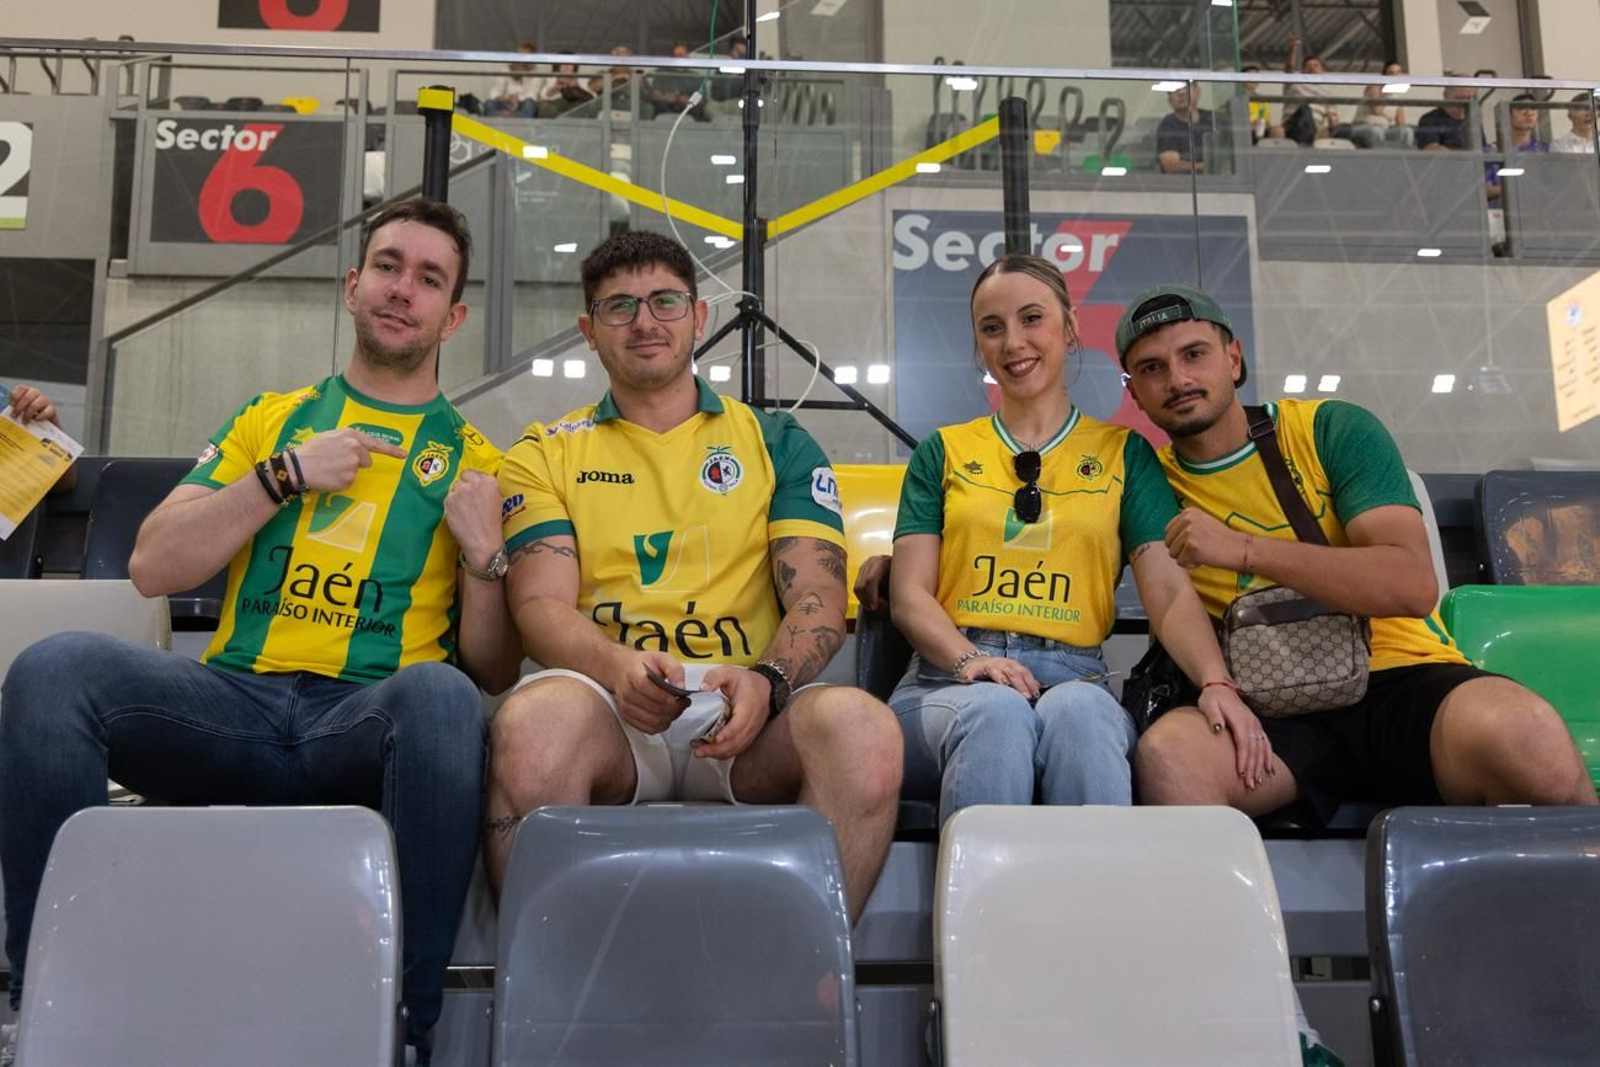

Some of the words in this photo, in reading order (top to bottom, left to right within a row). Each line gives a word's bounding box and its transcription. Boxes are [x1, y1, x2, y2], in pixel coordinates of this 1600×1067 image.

[156, 120, 277, 152] Sector
[198, 123, 305, 244] 6
[264, 545, 384, 613] Jaén
[972, 555, 1071, 603] Jaén
[241, 597, 308, 620] PARAÍSO
[312, 607, 396, 637] INTERIOR
[592, 601, 752, 659] Jaén
[956, 598, 1014, 614] PARAÍSO
[1017, 602, 1081, 623] INTERIOR
